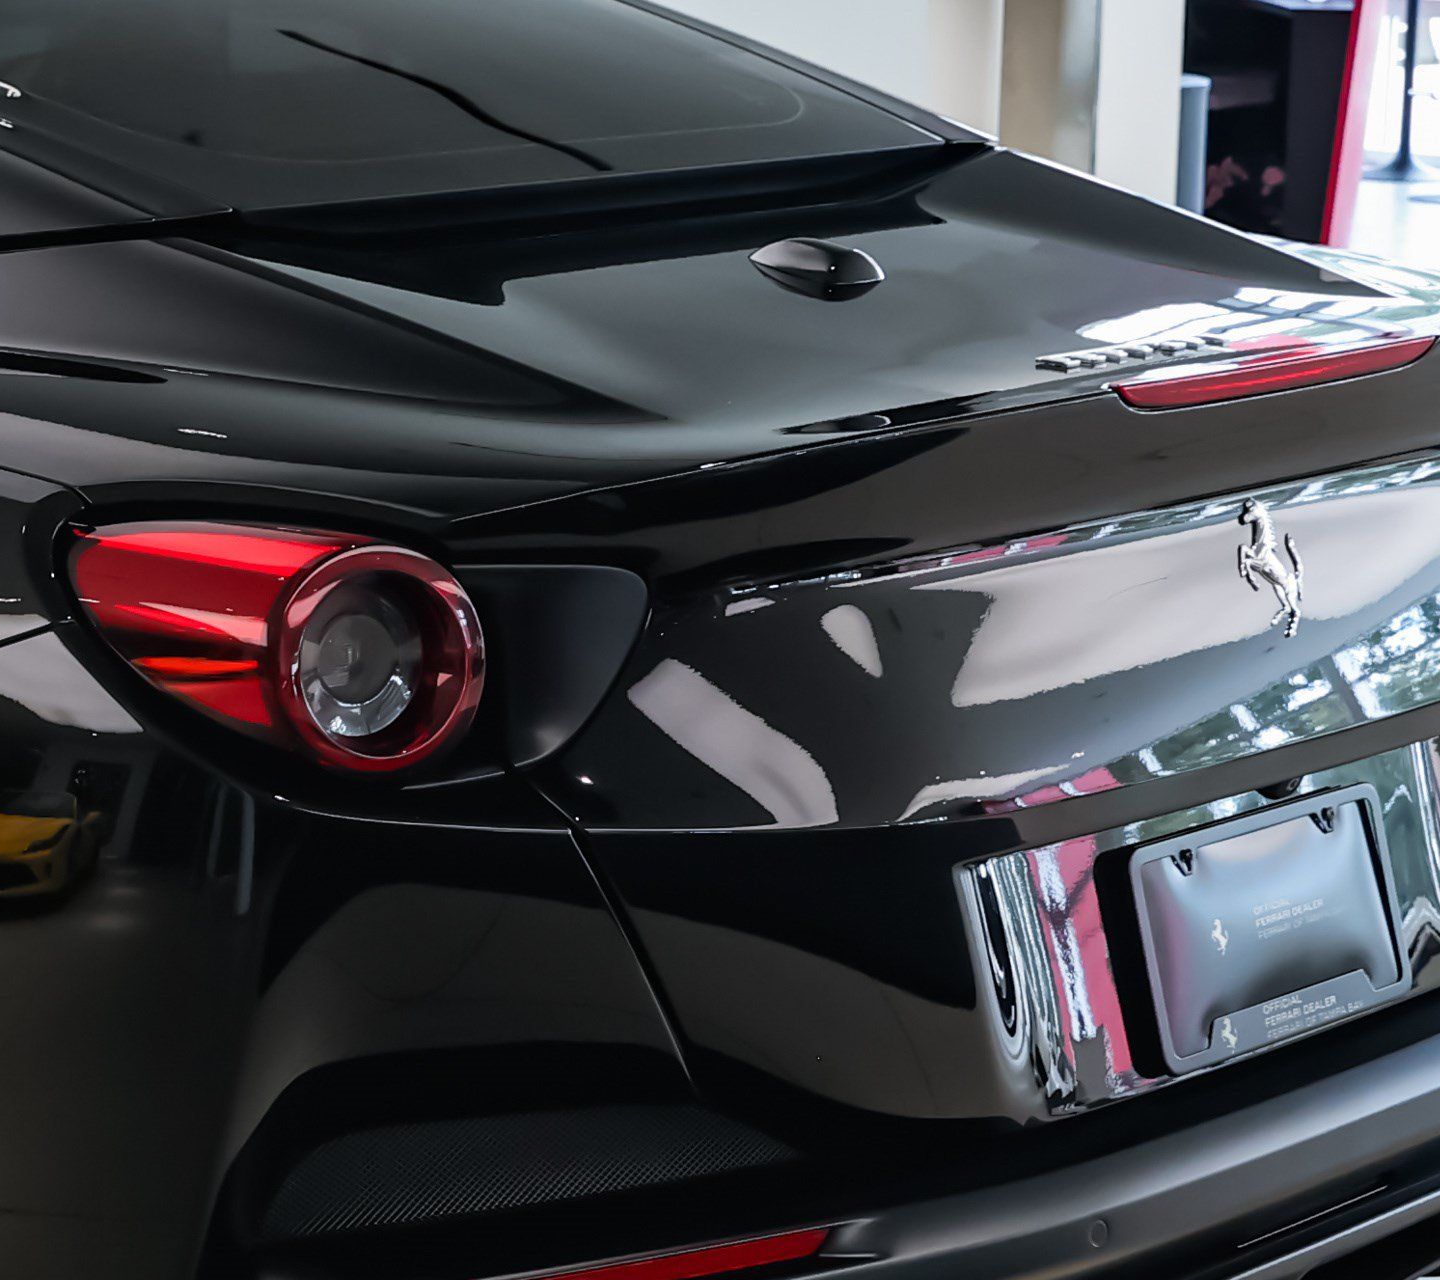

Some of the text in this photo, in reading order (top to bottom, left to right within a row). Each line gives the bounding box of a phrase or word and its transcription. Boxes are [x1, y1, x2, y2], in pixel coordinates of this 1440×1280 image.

[1263, 995, 1302, 1014] OFFICIAL
[1265, 995, 1337, 1027] FERRARI DEALER
